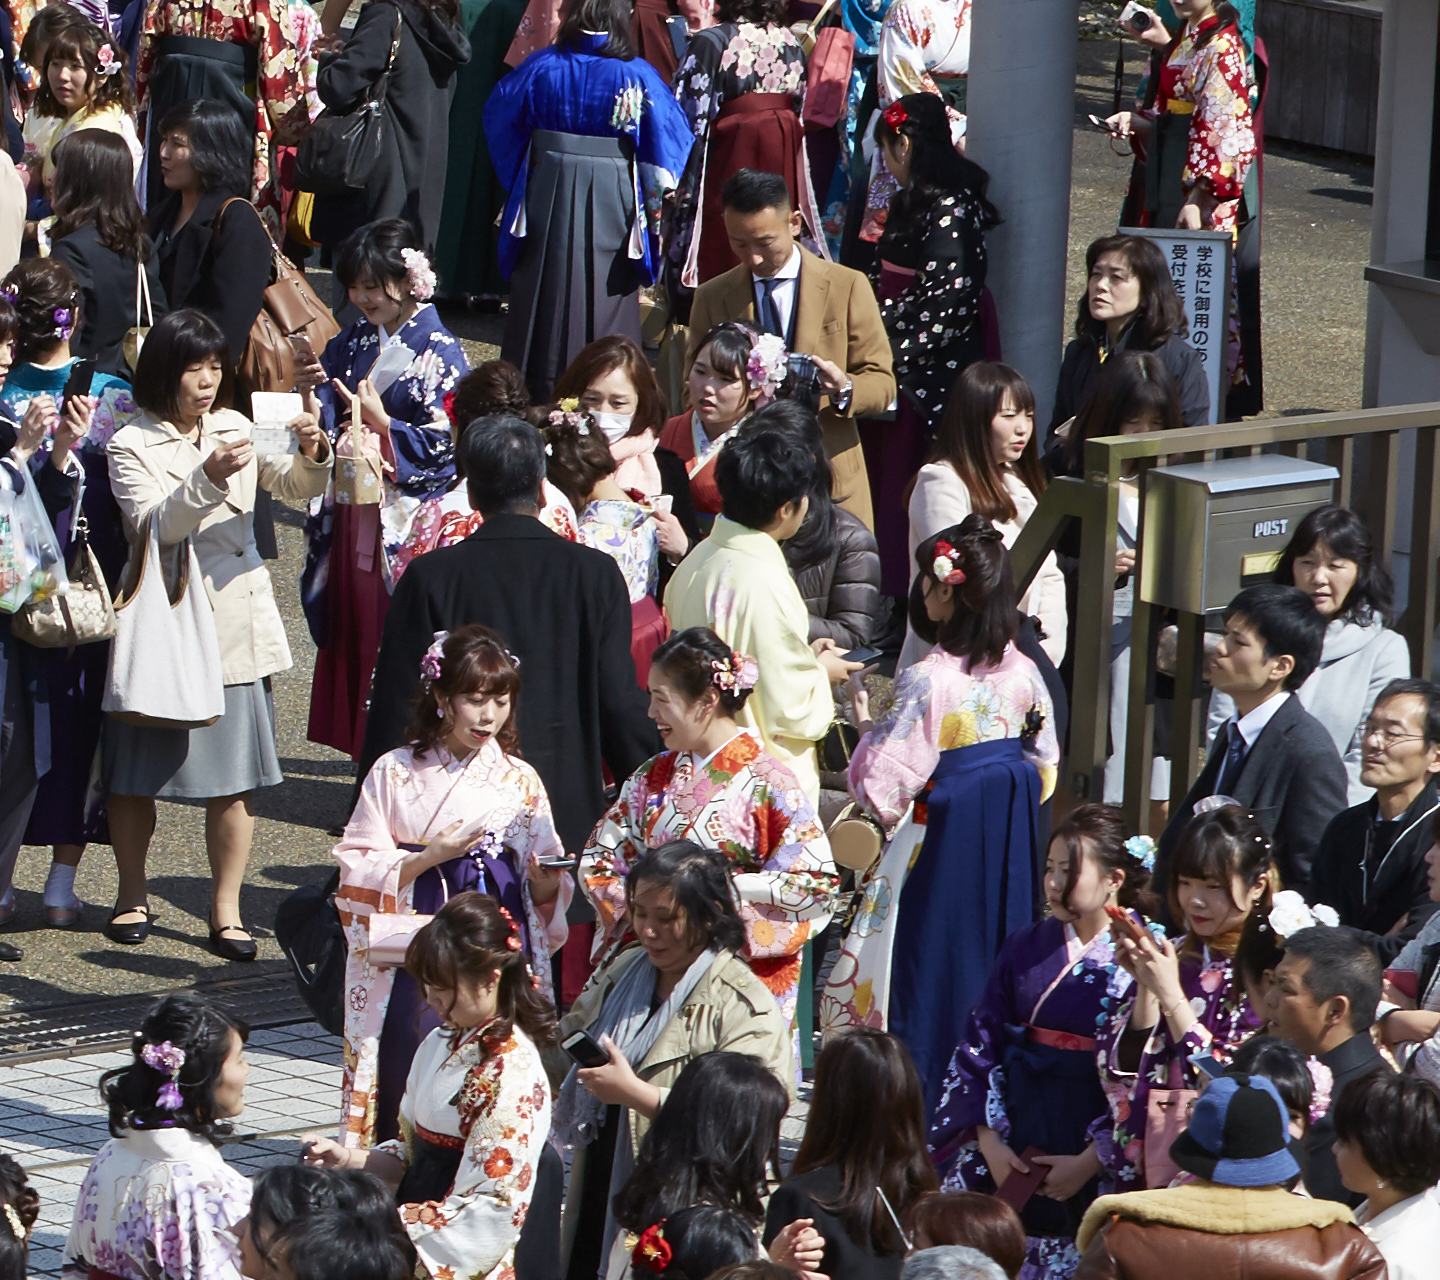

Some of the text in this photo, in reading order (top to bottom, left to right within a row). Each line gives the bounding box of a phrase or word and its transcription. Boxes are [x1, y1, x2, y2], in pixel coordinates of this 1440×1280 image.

[1168, 244, 1188, 302] 受付を
[1253, 519, 1288, 538] POST
